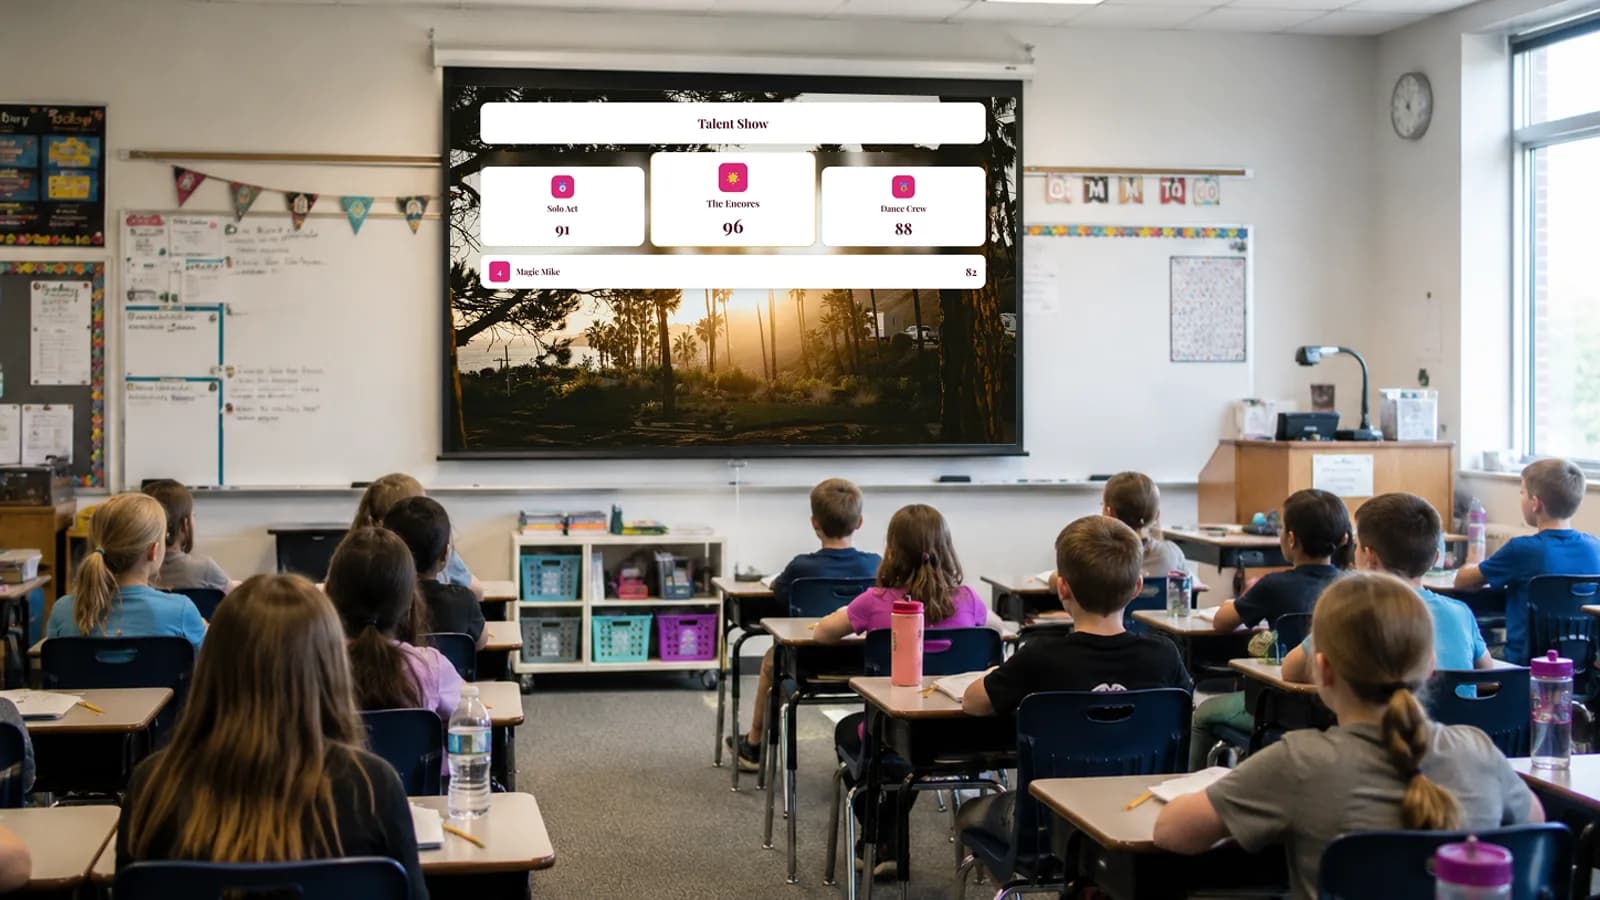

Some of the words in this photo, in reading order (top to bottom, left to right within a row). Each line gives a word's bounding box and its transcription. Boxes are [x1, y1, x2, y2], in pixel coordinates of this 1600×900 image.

[698, 118, 735, 130] Talent
[737, 118, 769, 130] Show
[547, 204, 564, 213] Solo
[565, 204, 578, 213] Act
[707, 199, 724, 209] The
[726, 199, 761, 209] Encores
[881, 204, 905, 213] Dance
[906, 204, 927, 213] Crew
[555, 225, 570, 238] 91
[723, 219, 744, 237] 96
[895, 222, 913, 236] 88
[496, 268, 504, 279] 4
[516, 267, 539, 278] Magic
[541, 267, 561, 277] Mike
[966, 267, 977, 277] 82
